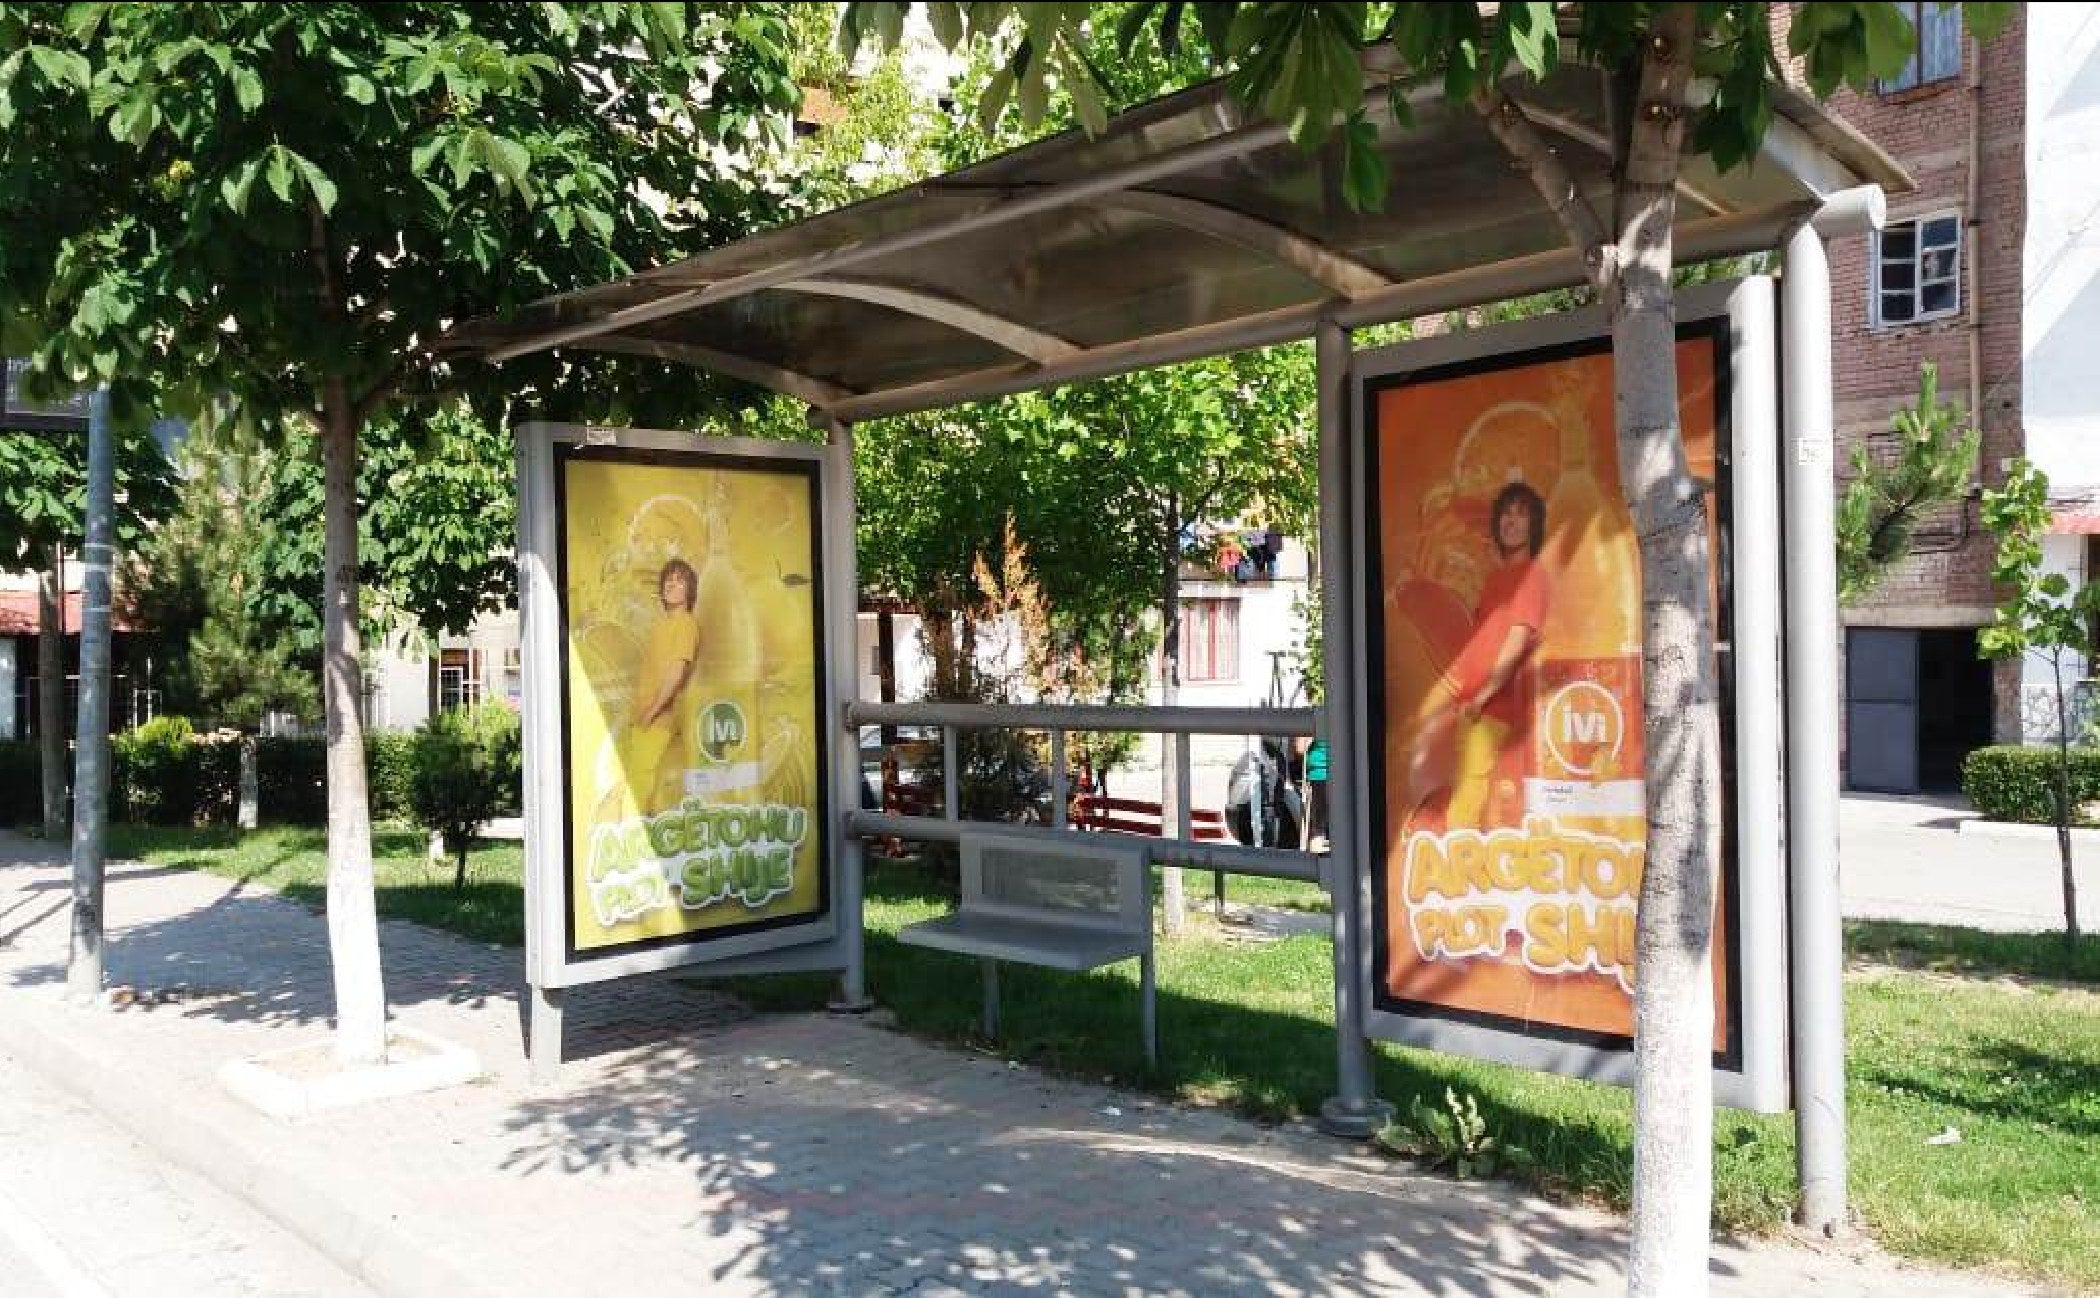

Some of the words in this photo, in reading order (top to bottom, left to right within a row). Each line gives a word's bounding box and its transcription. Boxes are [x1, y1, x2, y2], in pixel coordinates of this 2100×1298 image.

[1407, 815, 1646, 904] ARGËTO
[1413, 904, 1510, 958] PLOT
[1524, 901, 1638, 982] SHI
